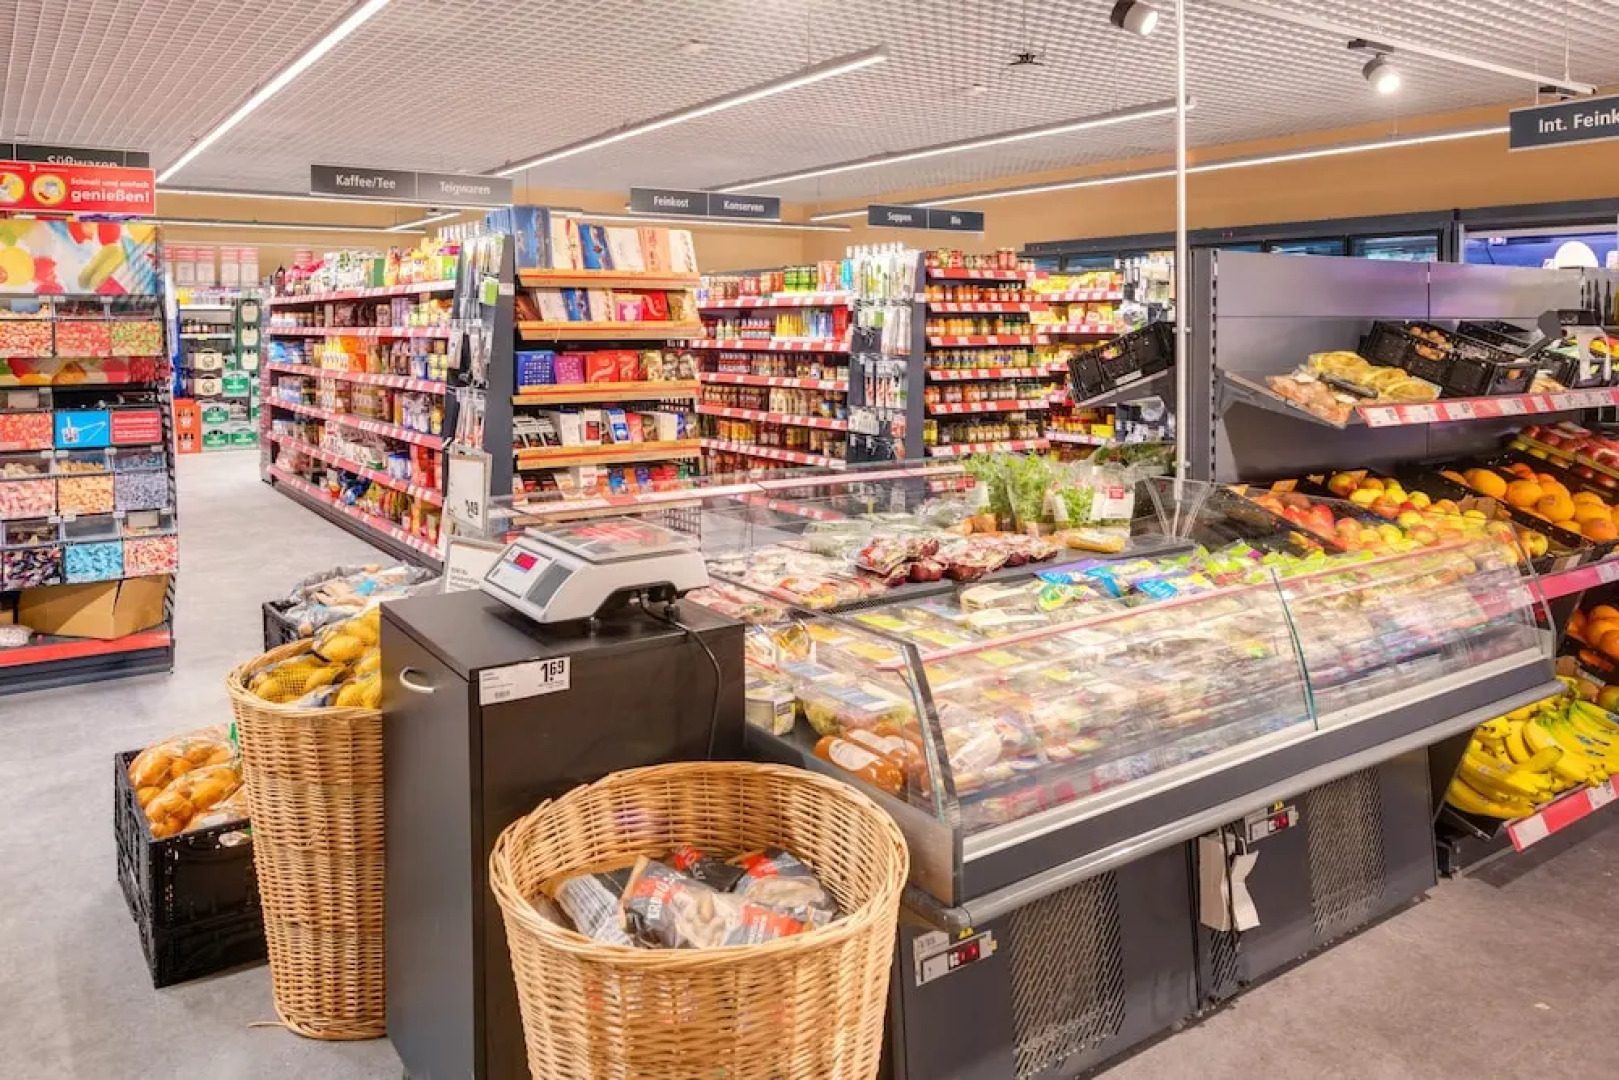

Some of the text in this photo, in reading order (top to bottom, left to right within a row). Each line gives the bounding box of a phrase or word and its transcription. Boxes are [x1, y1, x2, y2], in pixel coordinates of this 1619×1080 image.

[1538, 117, 1567, 133] Int.
[71, 178, 101, 186] Schnell
[119, 180, 149, 188] einfach
[336, 174, 396, 189] Kaffee/Tee
[440, 181, 491, 195] Teigwaren
[71, 190, 149, 203] genießen!
[653, 195, 689, 208] Feinkost
[723, 200, 765, 213] Konserven
